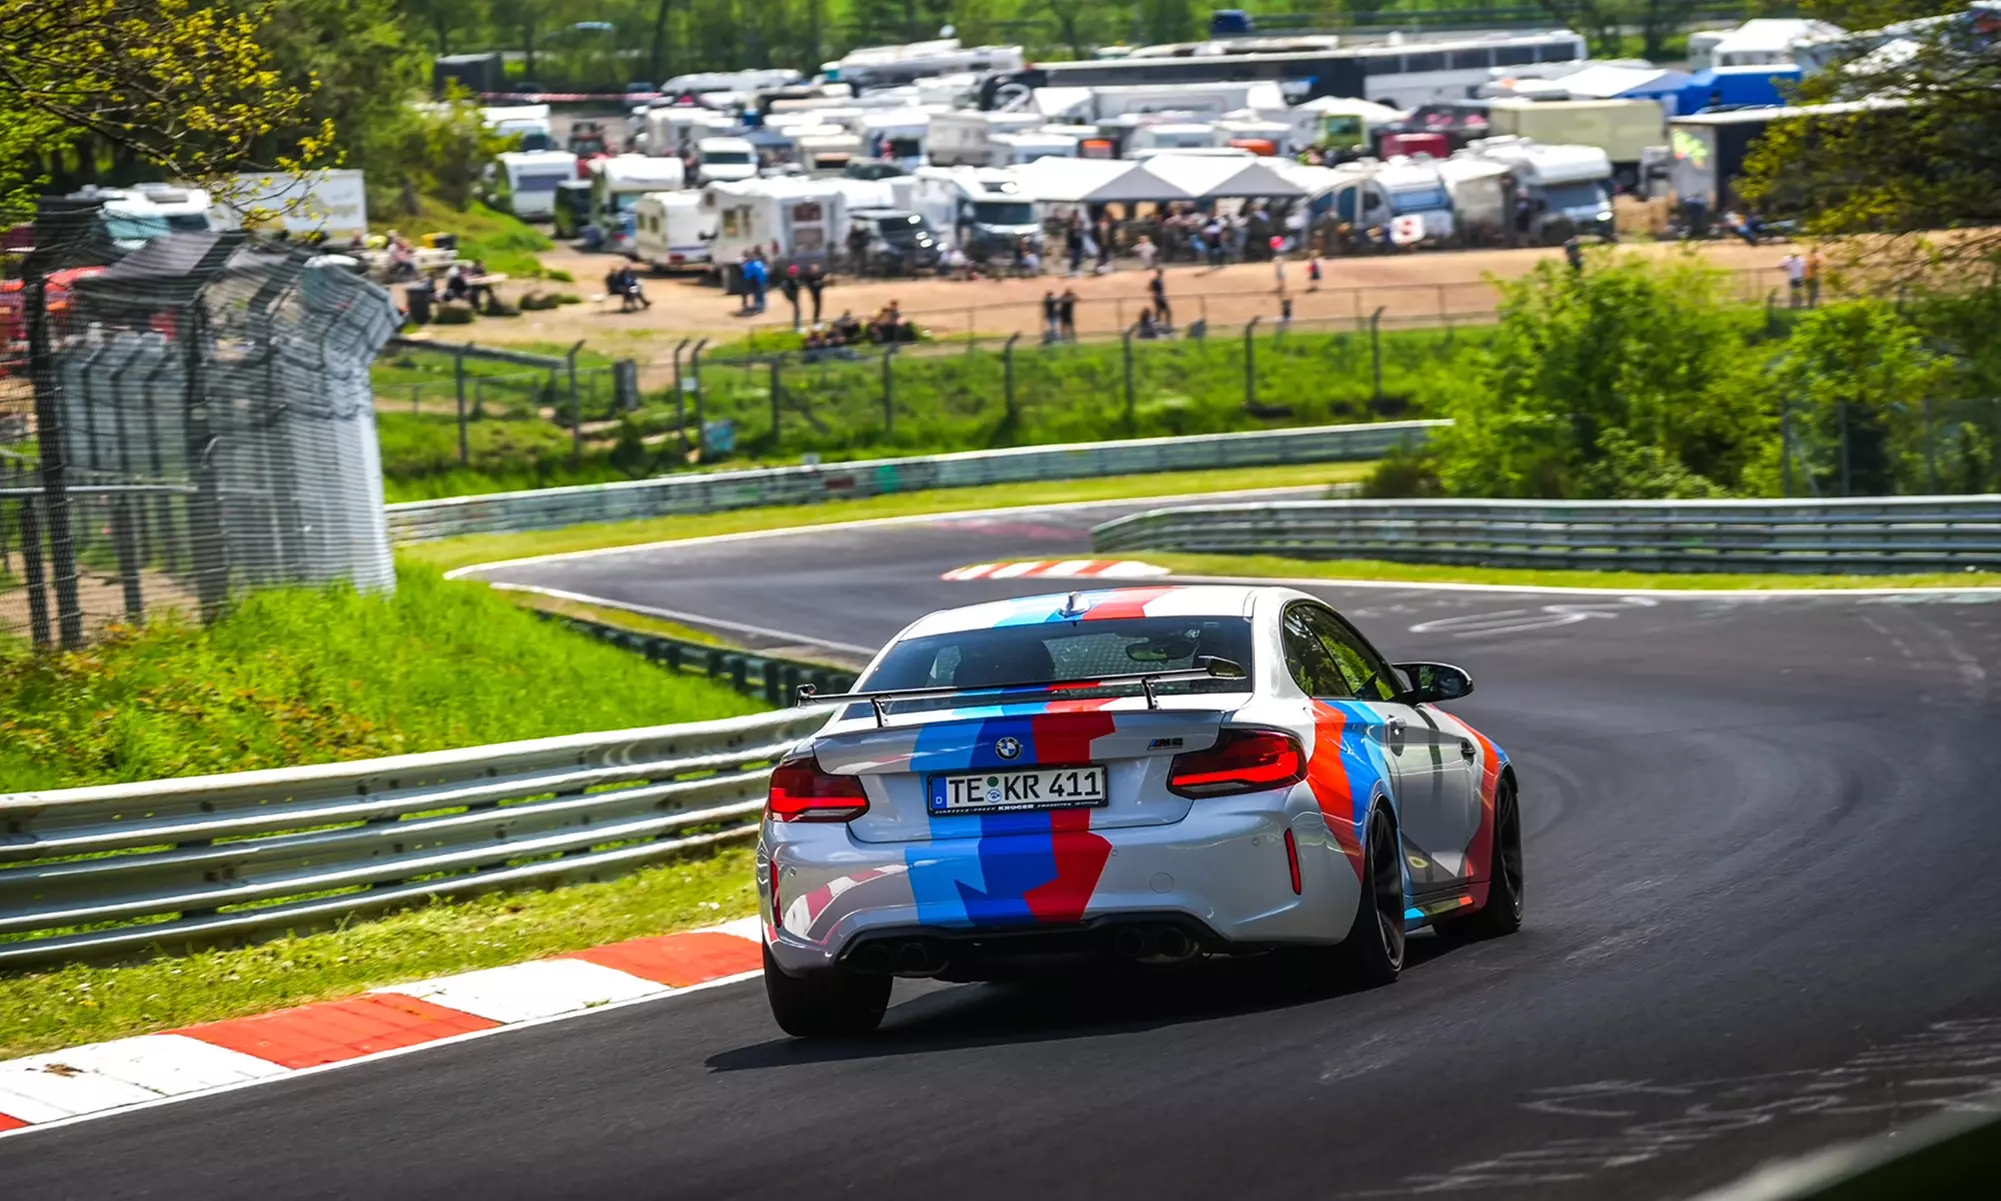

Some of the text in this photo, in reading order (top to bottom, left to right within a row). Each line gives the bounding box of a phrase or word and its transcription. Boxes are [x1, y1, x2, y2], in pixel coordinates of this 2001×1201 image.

[948, 777, 985, 804] TE
[1004, 774, 1041, 801] KR
[1048, 771, 1101, 798] 411
